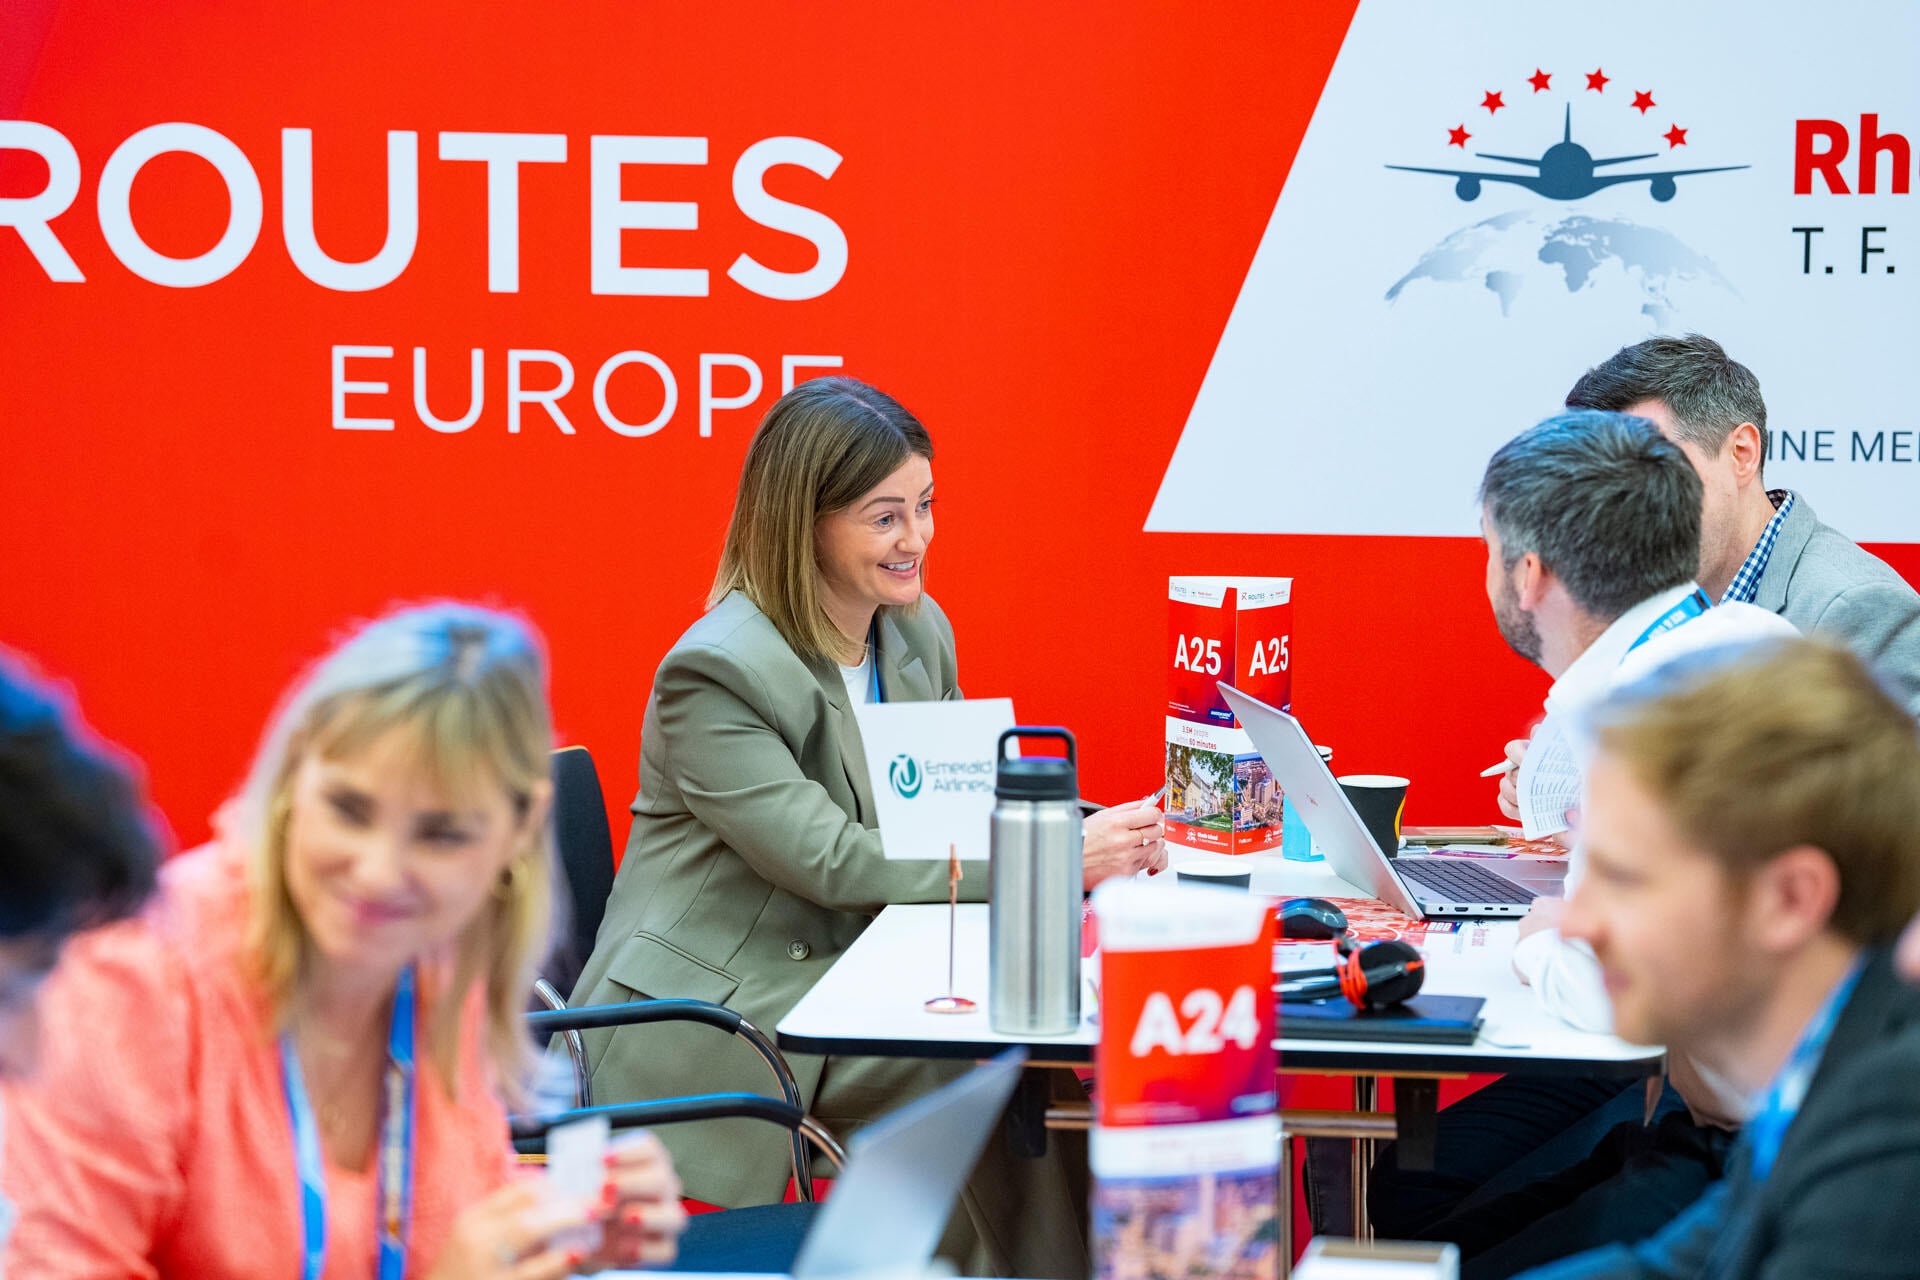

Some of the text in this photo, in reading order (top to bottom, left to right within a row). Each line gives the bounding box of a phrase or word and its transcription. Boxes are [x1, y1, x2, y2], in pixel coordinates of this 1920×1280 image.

[1793, 112, 1920, 195] Rh
[0, 120, 850, 301] ROUTES
[1792, 226, 1895, 275] T. F.
[1852, 431, 1920, 462] ME
[1173, 633, 1222, 676] A25
[1248, 634, 1289, 677] A25
[924, 759, 992, 775] Emerald
[1129, 983, 1261, 1058] A24
